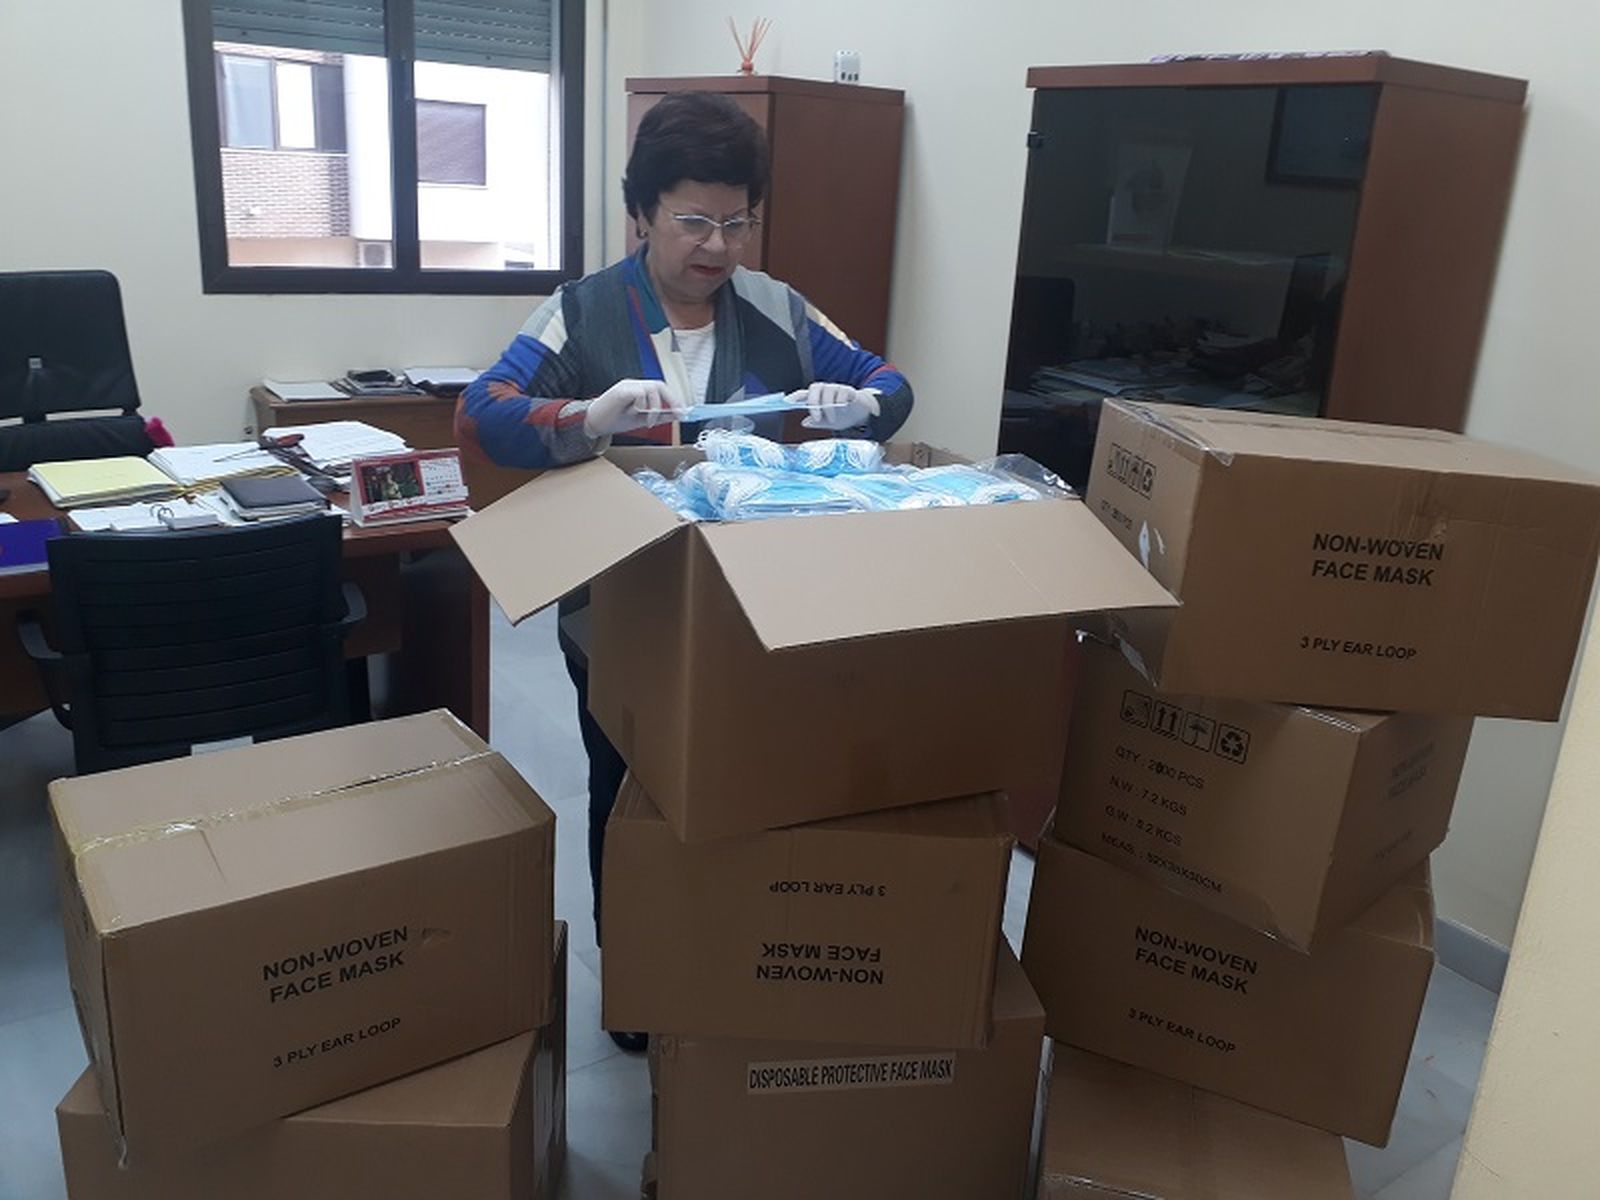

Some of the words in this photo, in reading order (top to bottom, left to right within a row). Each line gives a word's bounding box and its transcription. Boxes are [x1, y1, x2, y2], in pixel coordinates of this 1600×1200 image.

[1313, 533, 1444, 561] NON-WOVEN
[1311, 560, 1369, 581] FACE
[1373, 565, 1435, 587] MASK
[1300, 636, 1310, 649] 3
[1312, 637, 1341, 651] PLY
[1343, 641, 1373, 655] EAR
[1376, 645, 1417, 660] LOOP
[1115, 746, 1141, 762] QTY
[1177, 771, 1204, 790] PCS
[1161, 798, 1187, 816] KGS
[1155, 828, 1182, 847] KGS
[769, 880, 810, 894] LOOP
[813, 881, 844, 895] EAR
[848, 884, 875, 897] PLY
[878, 885, 887, 897] 3
[263, 925, 408, 981] NON-WOVEN
[761, 942, 821, 959] MASK
[827, 944, 881, 963] FACE
[1135, 926, 1257, 974] NON-WOVEN
[269, 971, 333, 1003] FACE
[339, 950, 405, 982] MASK
[756, 964, 884, 985] NON-WOVEN
[1135, 947, 1186, 975] FACE
[1191, 964, 1249, 994] MASK
[273, 1055, 283, 1068] 3
[287, 1044, 317, 1064] PLY
[321, 1033, 355, 1052] EAR
[359, 1017, 401, 1040] LOOP
[1128, 1008, 1137, 1019] 3
[1138, 1011, 1165, 1027] PLY
[1166, 1021, 1195, 1039] EAR
[1197, 1033, 1236, 1053] LOOP
[749, 1064, 819, 1089] DISPOSABLE
[821, 1062, 888, 1085] PROTECTIVE
[890, 1060, 919, 1082] FACE
[920, 1059, 953, 1079] MASK
